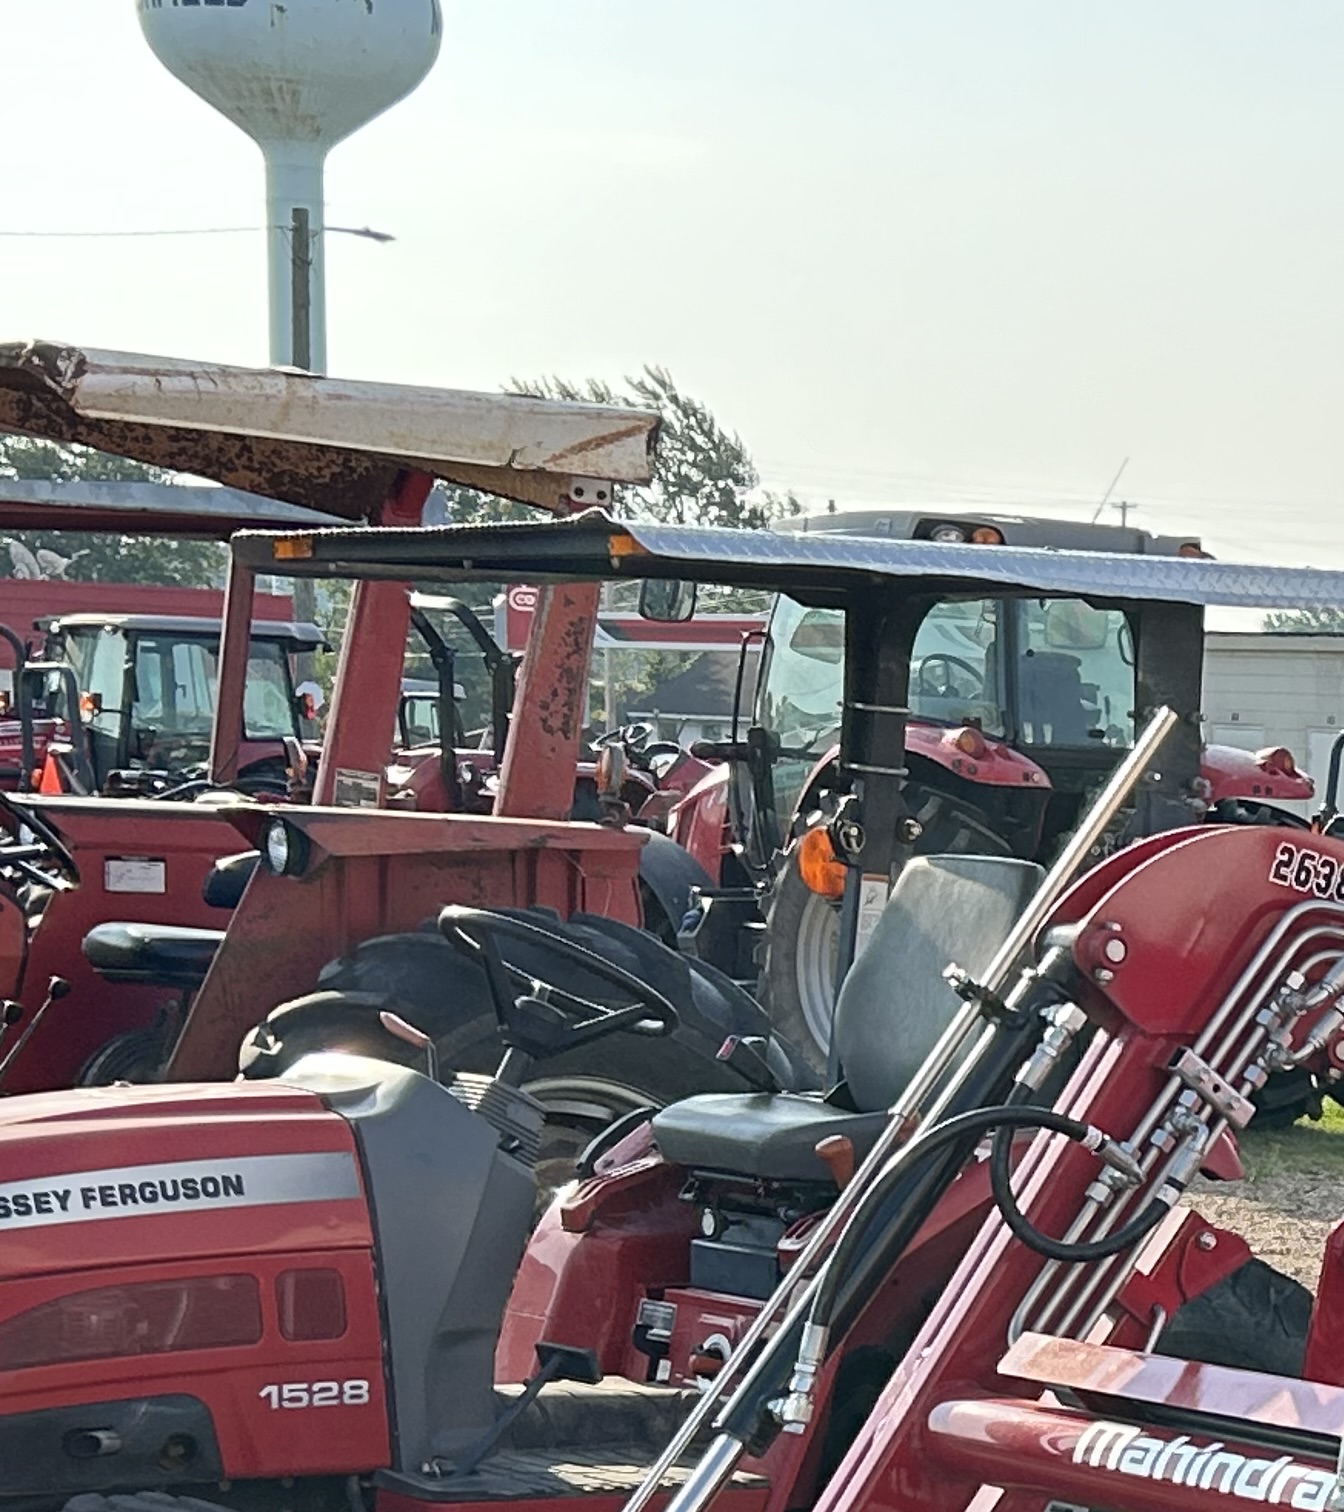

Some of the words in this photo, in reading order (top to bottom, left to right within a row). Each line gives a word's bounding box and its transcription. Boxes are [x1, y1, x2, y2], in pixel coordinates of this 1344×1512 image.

[80, 1174, 245, 1209] FERGUSON
[258, 1379, 369, 1410] 1528
[1072, 1420, 1339, 1512] Mahindra
